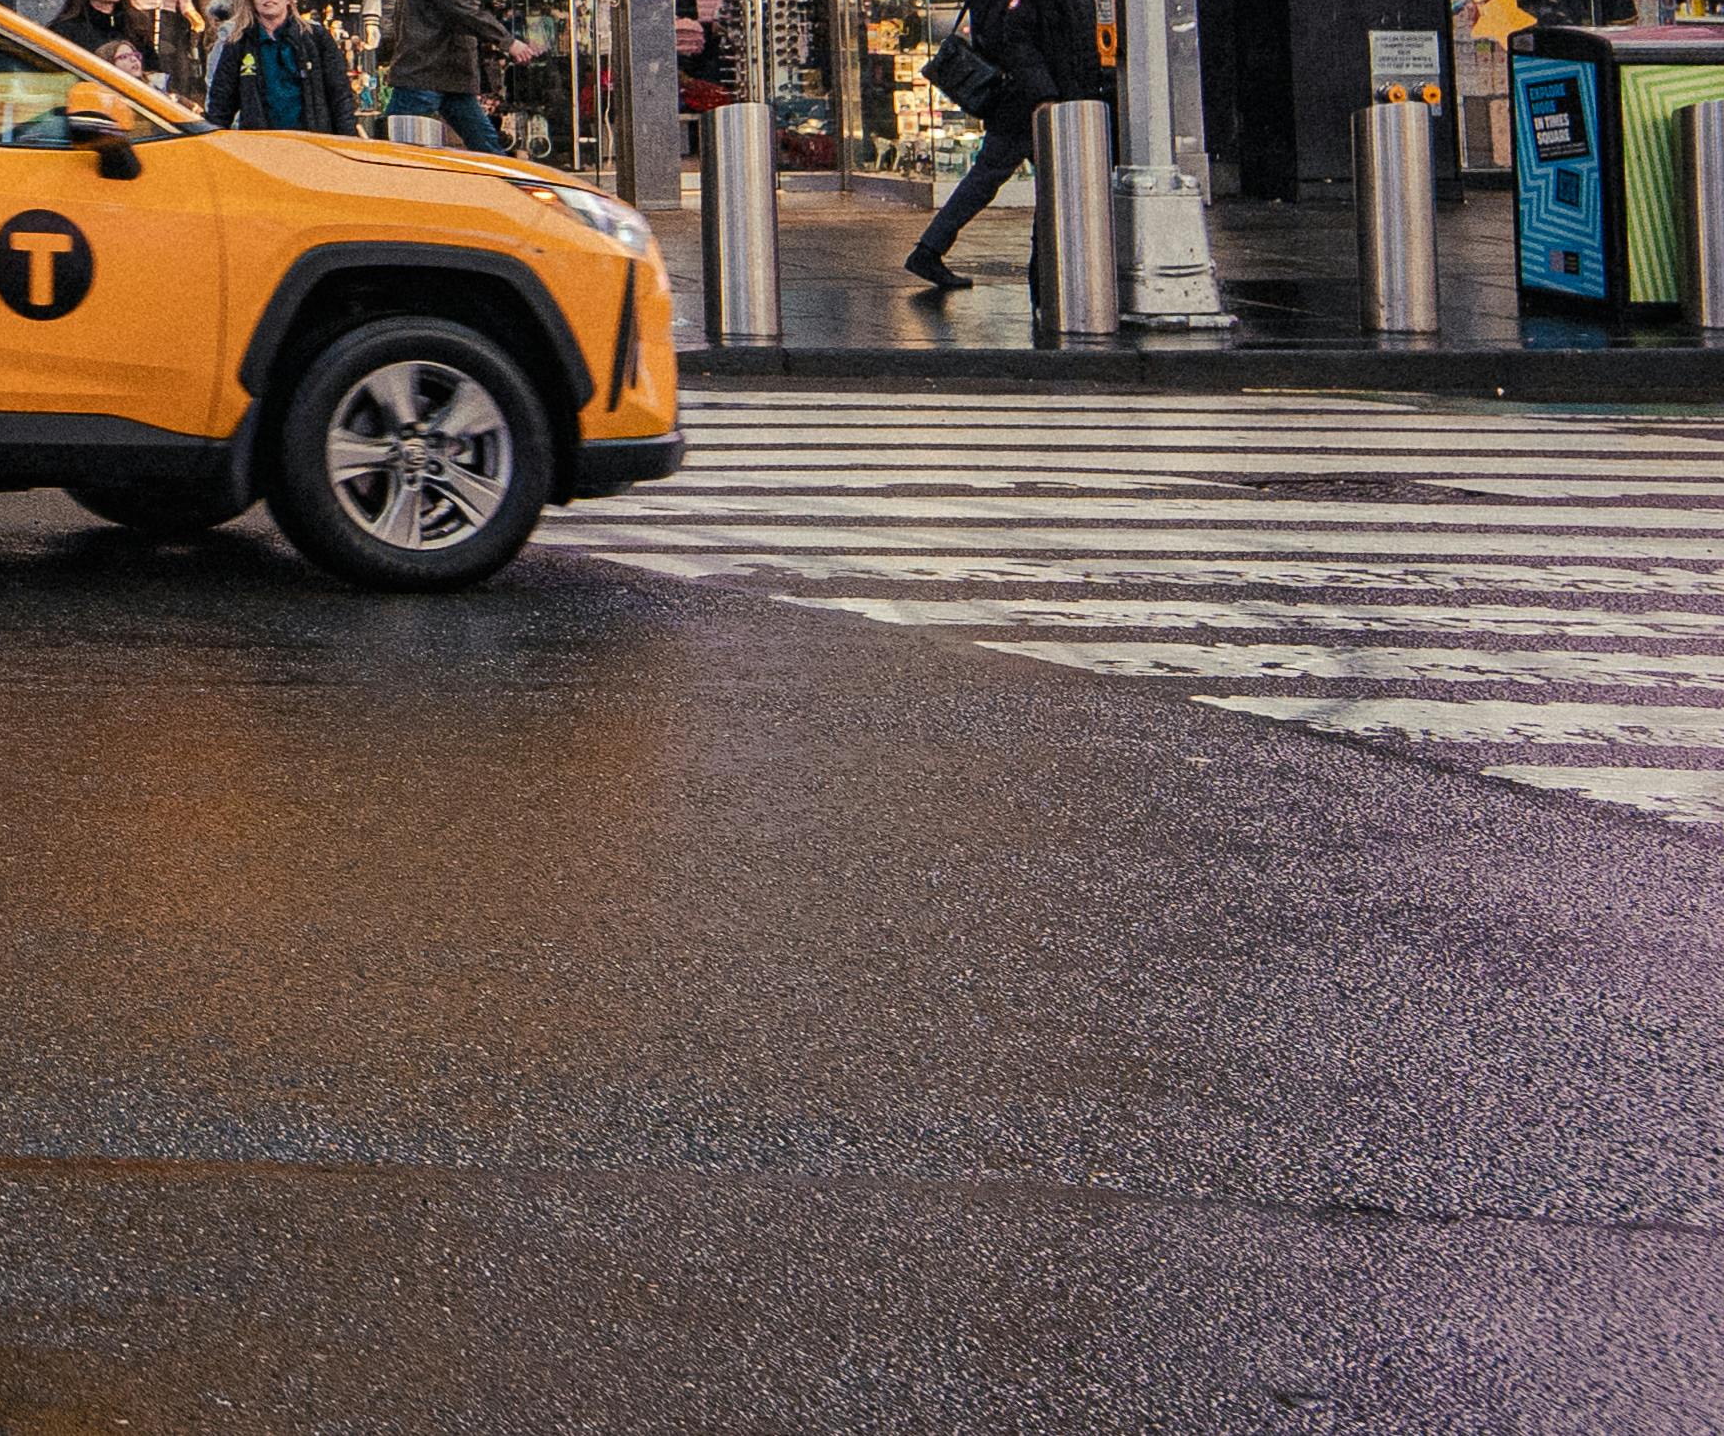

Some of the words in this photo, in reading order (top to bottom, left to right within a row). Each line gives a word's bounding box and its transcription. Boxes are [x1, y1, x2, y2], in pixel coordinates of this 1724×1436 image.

[1534, 116, 1545, 131] IN
[1544, 112, 1570, 129] TIMES
[1536, 127, 1571, 146] SQUARE
[8, 231, 74, 306] T
